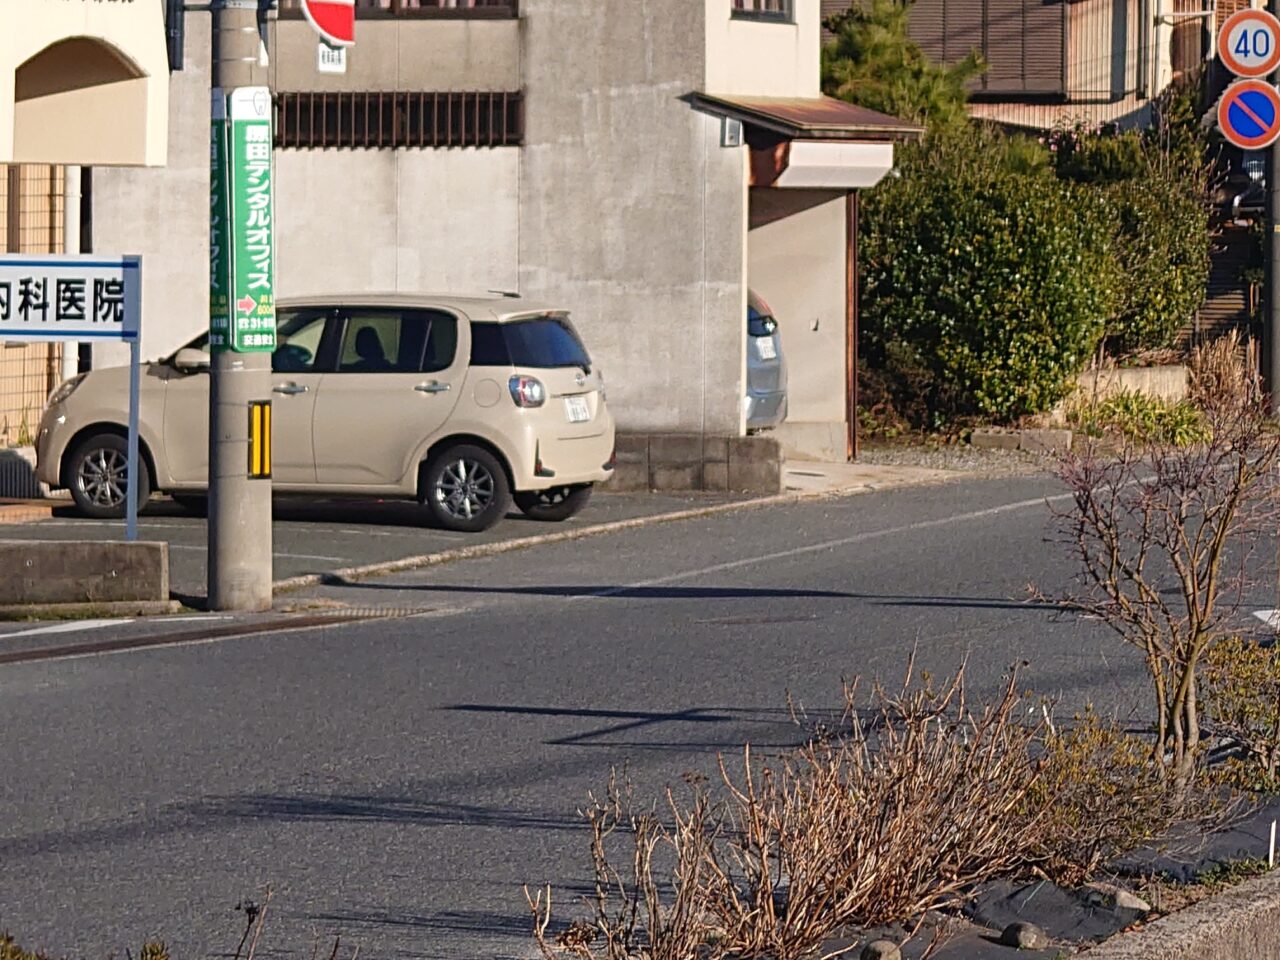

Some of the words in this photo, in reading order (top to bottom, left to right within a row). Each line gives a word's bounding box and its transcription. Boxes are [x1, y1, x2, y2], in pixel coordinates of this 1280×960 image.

[1235, 29, 1270, 58] 40
[246, 125, 271, 288] 原田デンタルオフィス
